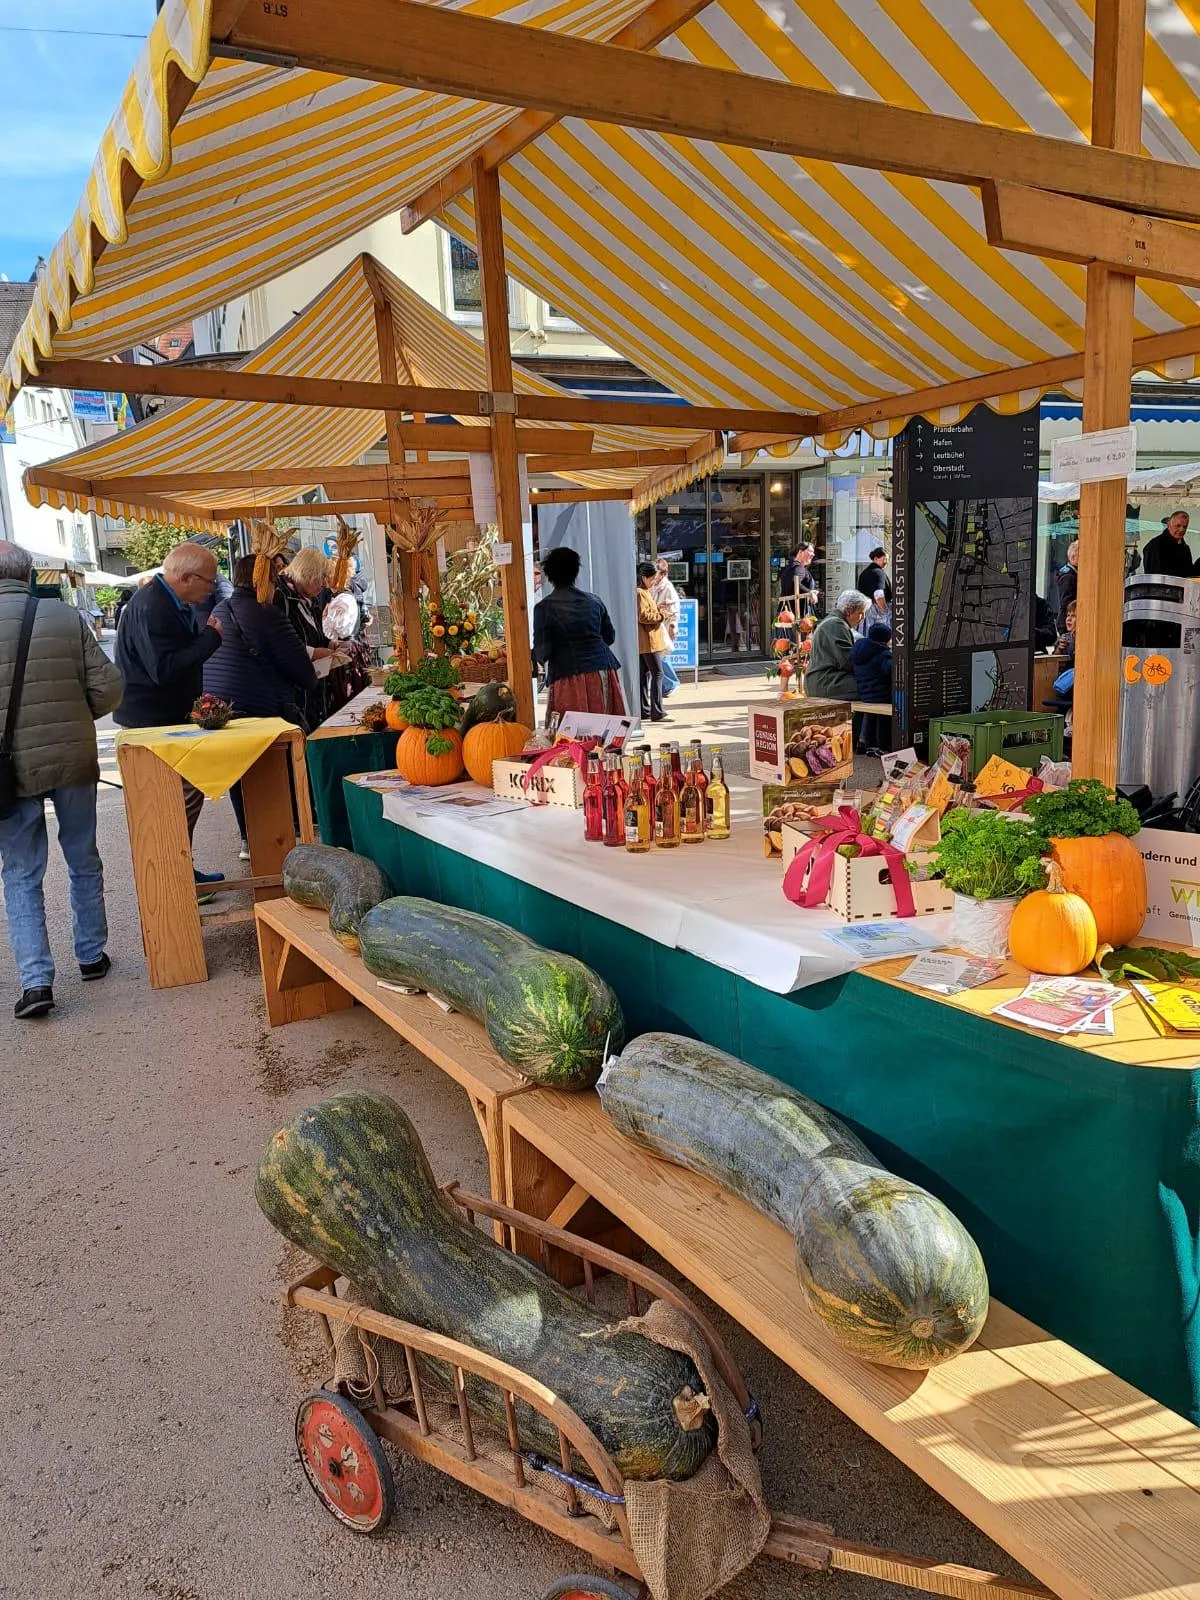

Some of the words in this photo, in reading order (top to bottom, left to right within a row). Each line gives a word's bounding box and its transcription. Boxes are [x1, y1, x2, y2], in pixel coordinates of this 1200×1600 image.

[896, 508, 905, 647] KAISERSTRASSE
[755, 730, 777, 741] GENUSS
[755, 740, 777, 751] REGION
[1139, 850, 1171, 863] ndern
[1174, 857, 1198, 867] und
[1146, 904, 1161, 915] aft
[1168, 911, 1200, 923] Gemeins
